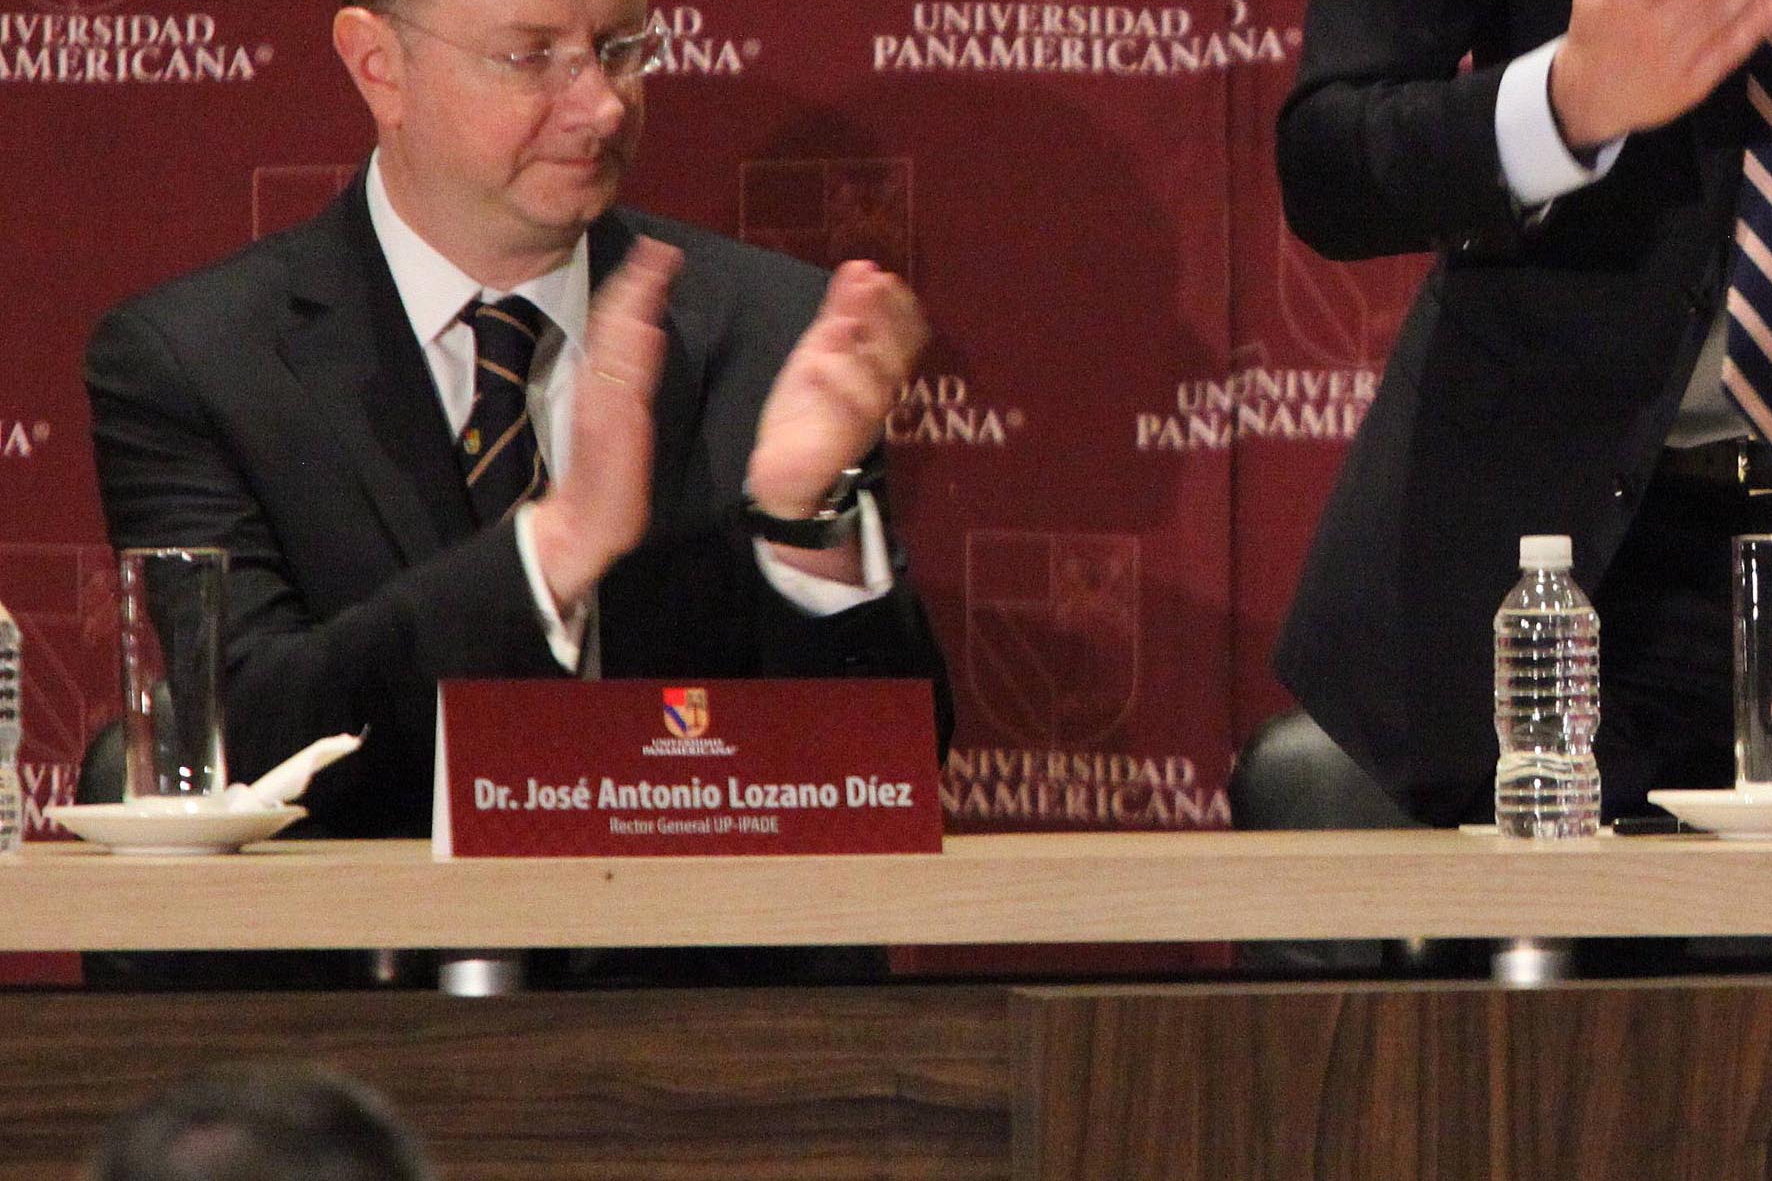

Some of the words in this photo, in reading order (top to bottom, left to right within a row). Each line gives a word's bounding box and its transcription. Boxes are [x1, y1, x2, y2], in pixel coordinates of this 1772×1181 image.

[0, 13, 216, 46] IVERSIDAD
[473, 777, 517, 811] Dr.
[522, 775, 589, 811] José
[596, 775, 722, 810] Antonio
[727, 775, 840, 810] Lozano
[844, 774, 913, 808] Díez
[609, 816, 654, 834] Rector
